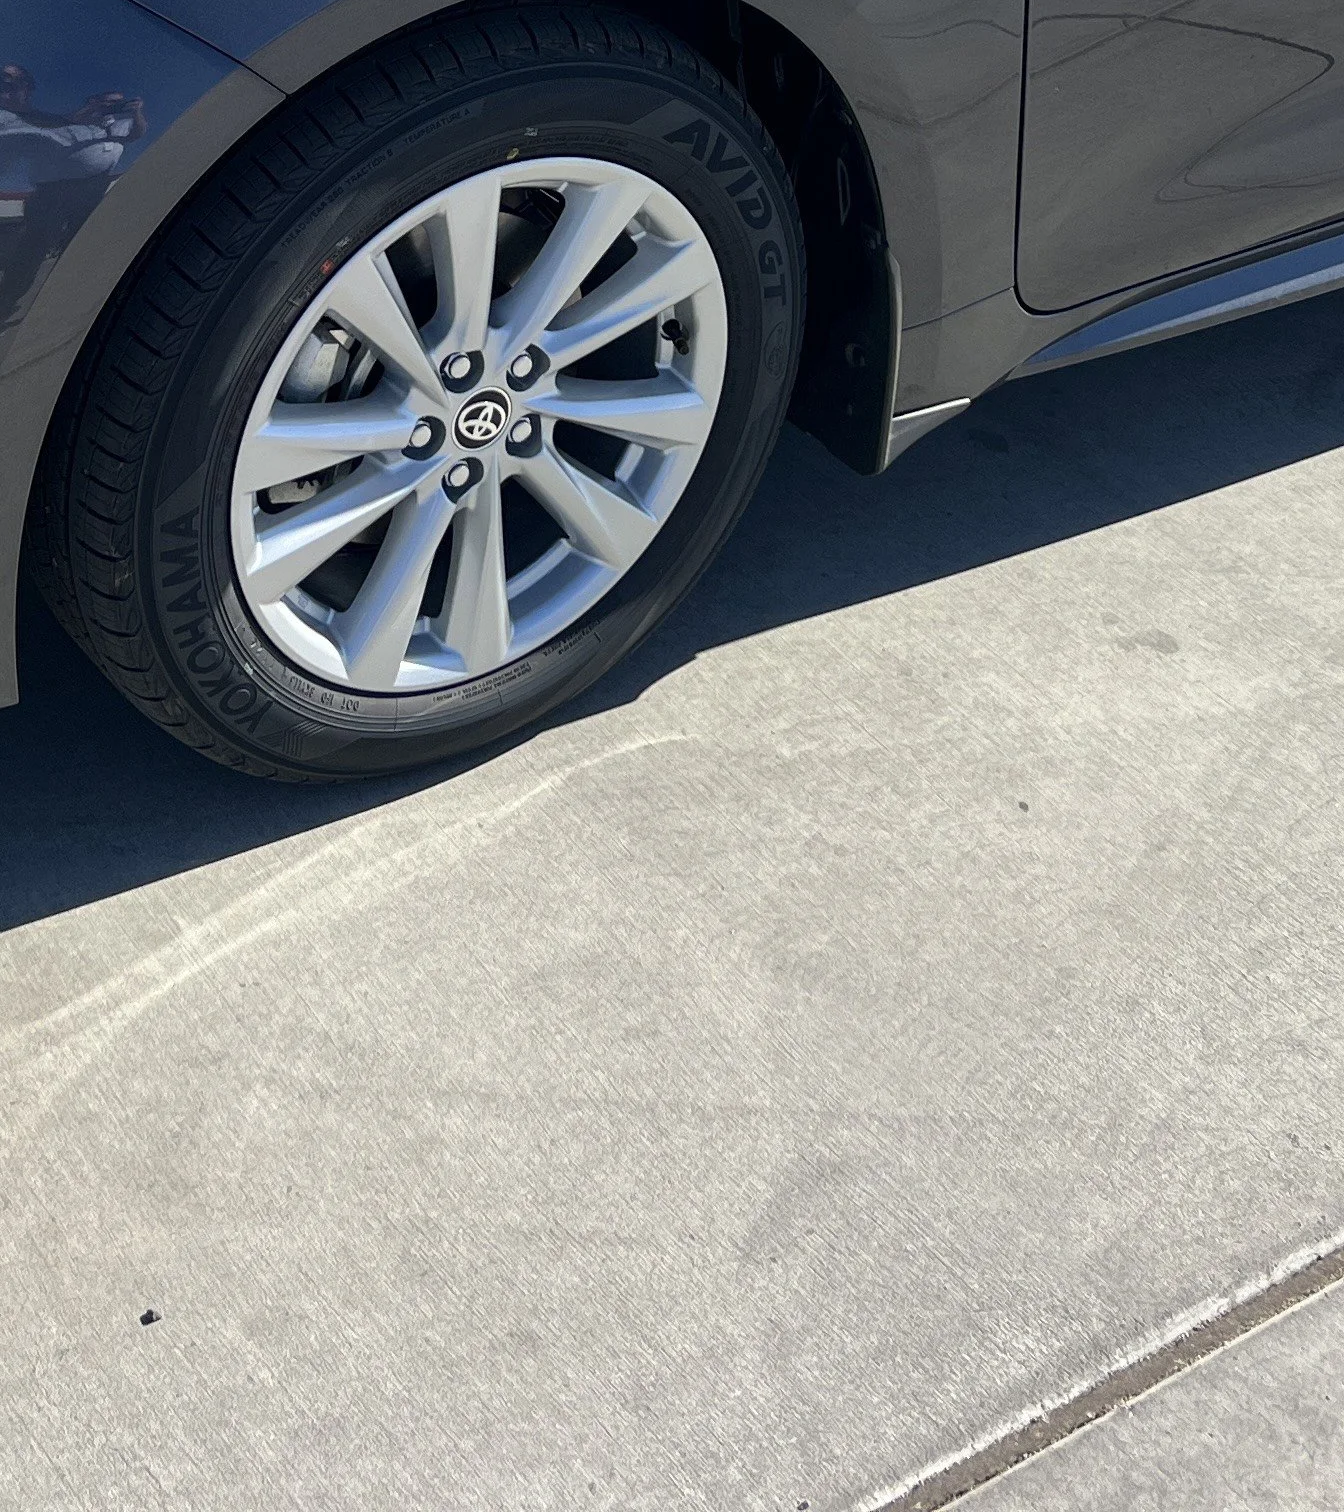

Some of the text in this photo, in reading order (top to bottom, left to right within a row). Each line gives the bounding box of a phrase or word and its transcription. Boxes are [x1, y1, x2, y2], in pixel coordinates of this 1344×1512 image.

[345, 156, 386, 184] TRACTION
[403, 113, 463, 145] TEMPERATURE
[462, 108, 470, 118] A
[661, 118, 787, 307] AVID GT
[160, 506, 274, 735] YOKOHAMA
